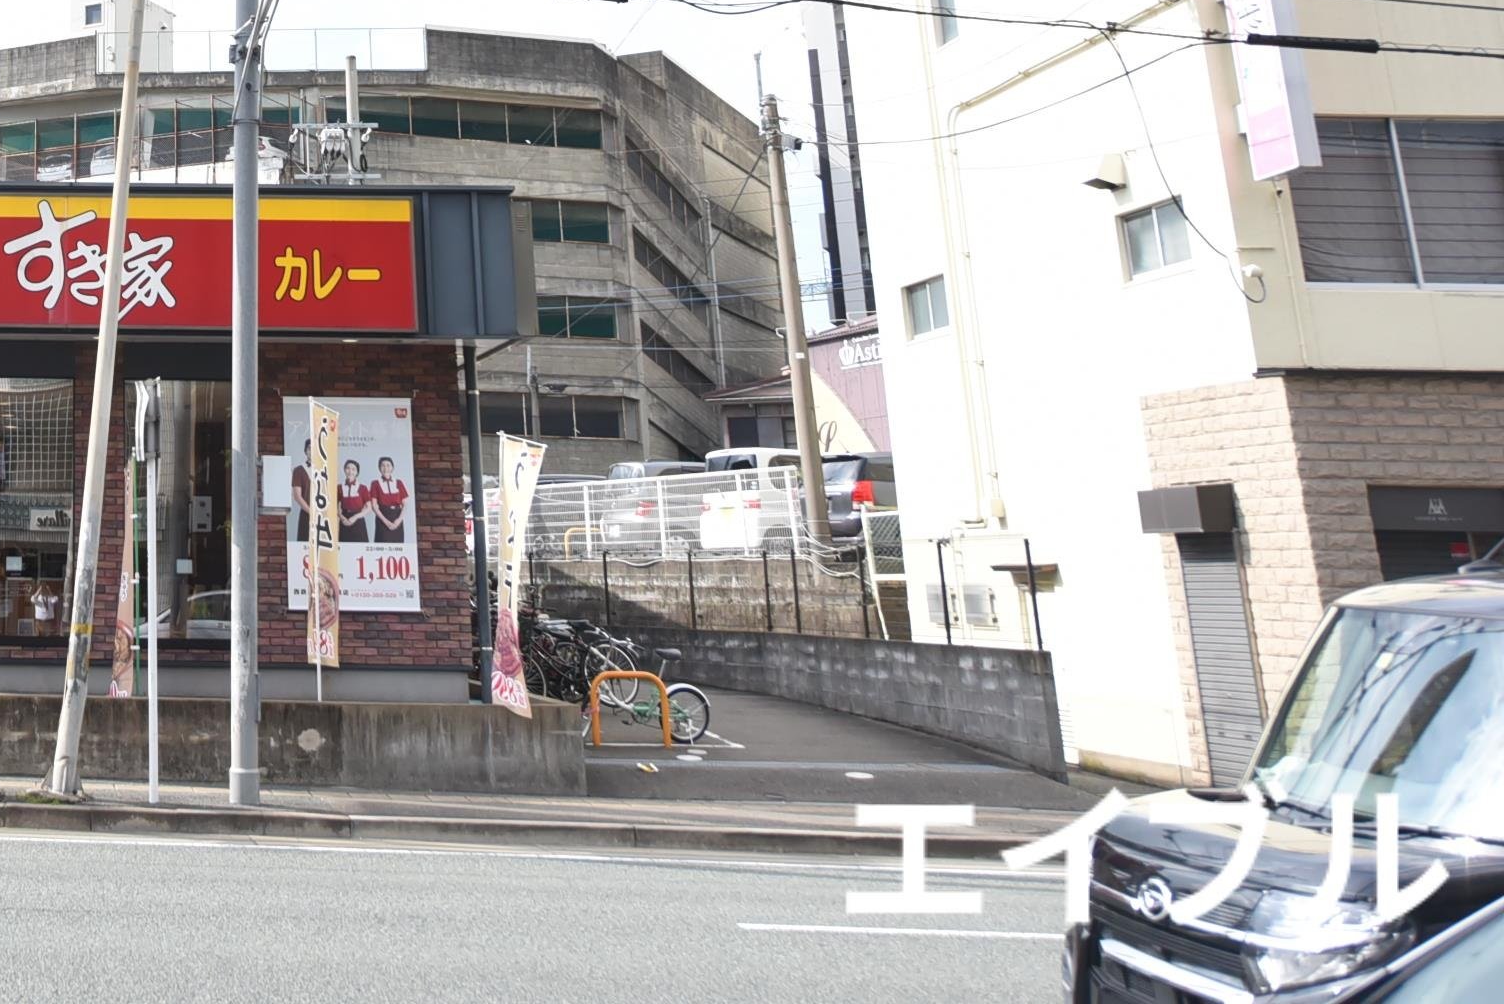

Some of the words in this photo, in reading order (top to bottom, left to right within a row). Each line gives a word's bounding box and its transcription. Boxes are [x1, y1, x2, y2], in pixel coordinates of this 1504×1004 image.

[3, 199, 176, 322] すき家
[274, 246, 381, 301] カレー
